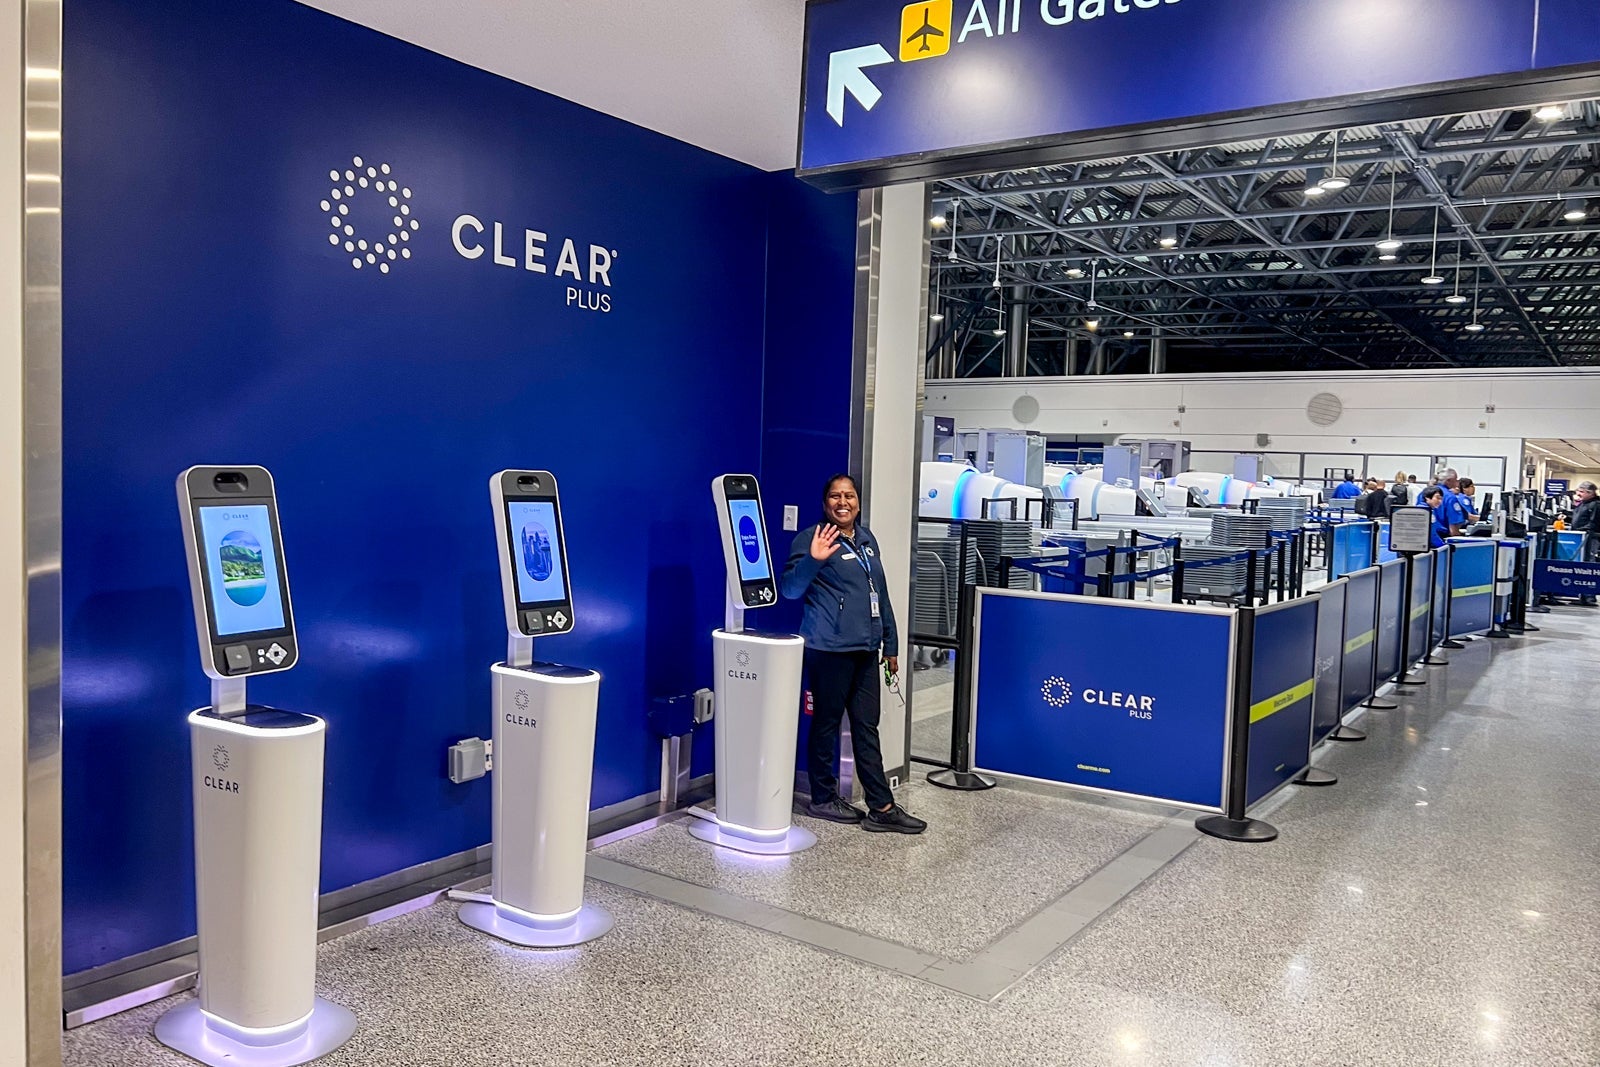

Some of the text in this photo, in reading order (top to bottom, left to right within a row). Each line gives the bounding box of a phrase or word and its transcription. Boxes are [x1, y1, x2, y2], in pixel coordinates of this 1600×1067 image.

[957, 0, 1021, 43] All
[566, 286, 611, 313] PLUS
[1547, 565, 1573, 574] Please
[1574, 567, 1592, 575] Wait
[728, 669, 757, 681] CLEAR
[505, 713, 537, 729] CLEAR
[1129, 709, 1152, 720] PLUS
[204, 775, 239, 794] CLEAR
